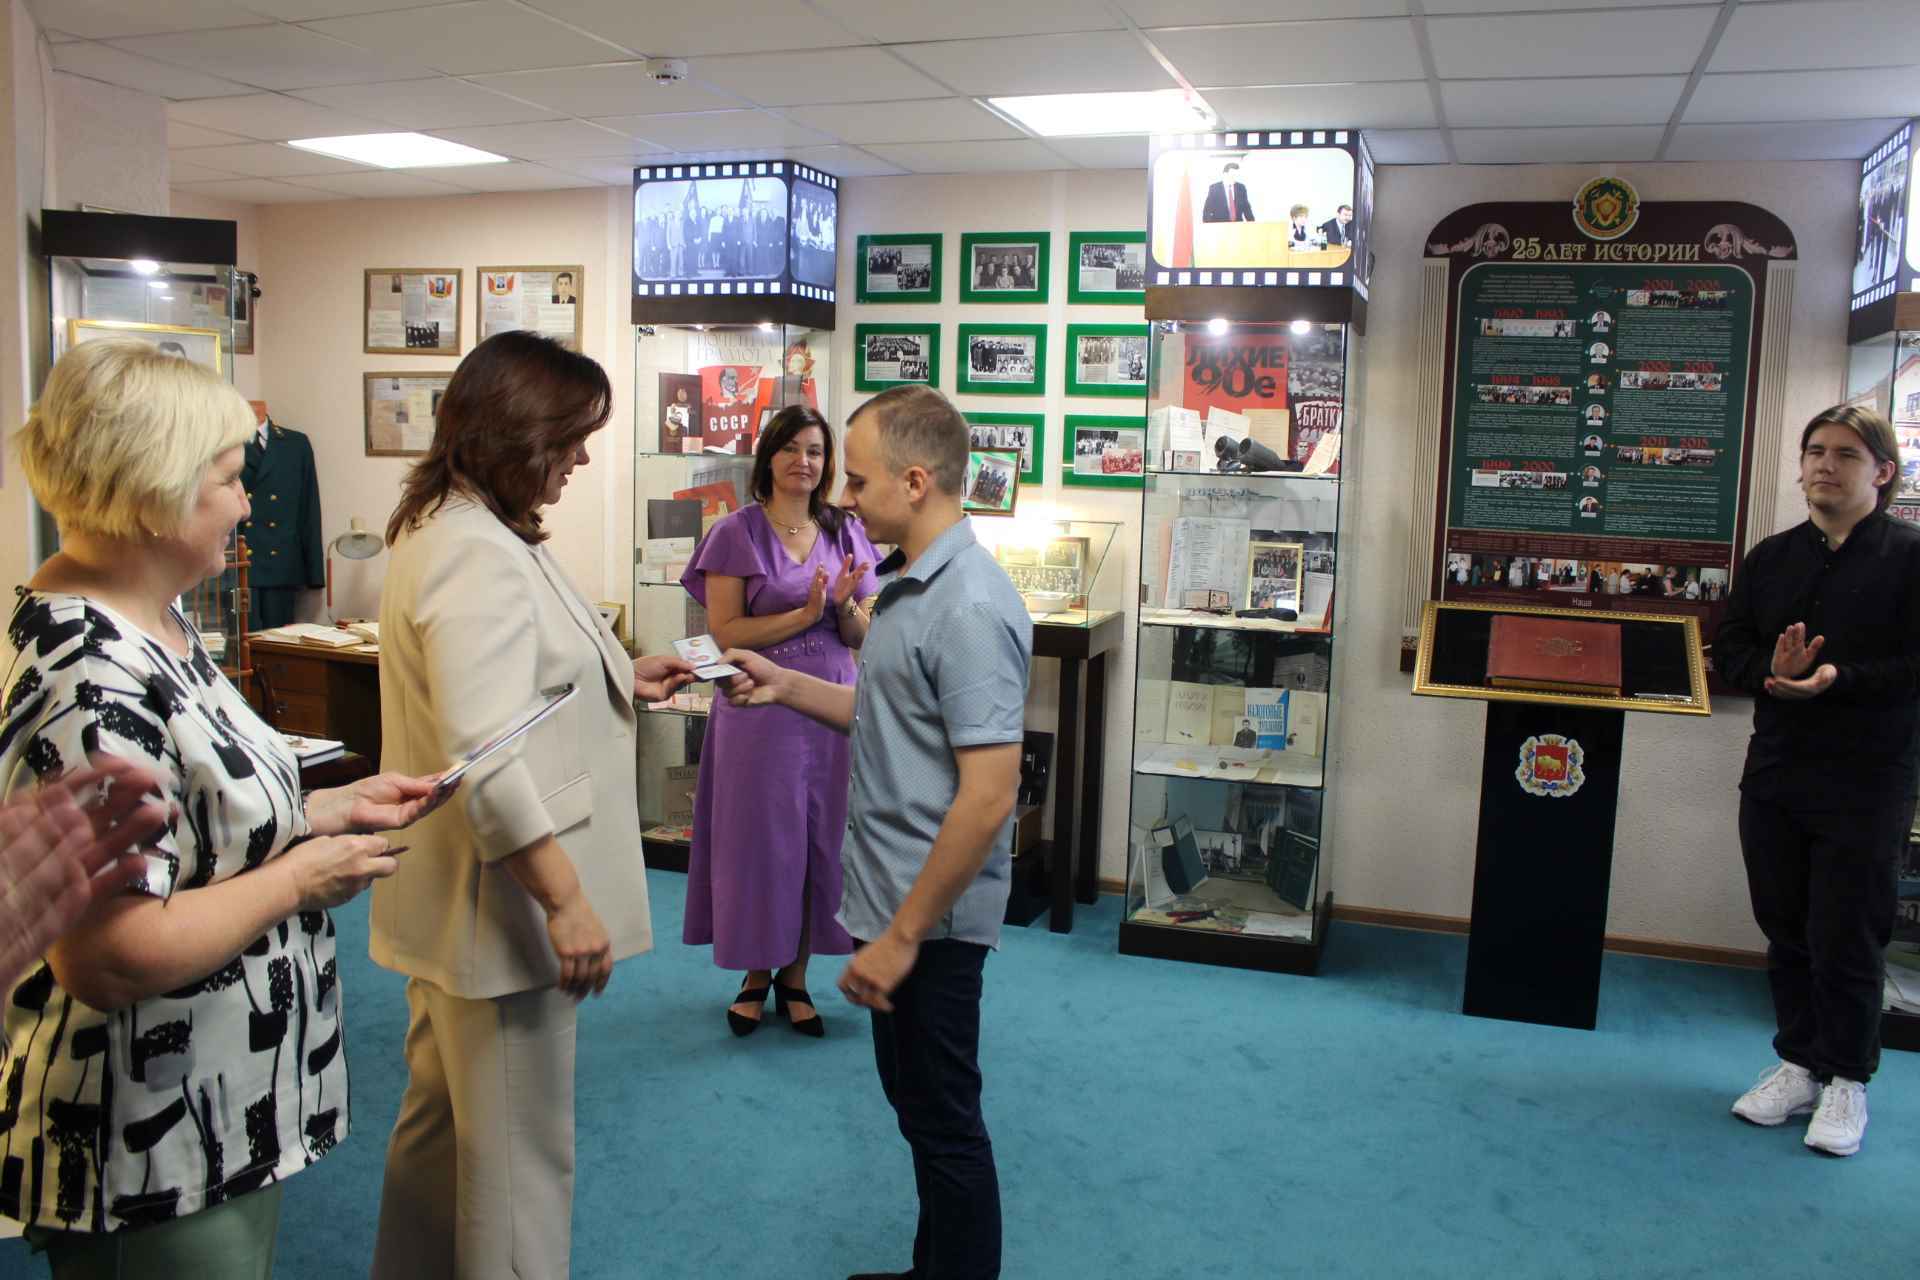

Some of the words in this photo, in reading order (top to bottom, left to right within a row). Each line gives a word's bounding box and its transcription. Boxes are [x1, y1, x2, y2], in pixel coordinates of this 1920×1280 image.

[1512, 238, 1541, 260] 25
[1544, 243, 1586, 261] ЛЕТ
[1595, 242, 1700, 262] ИСТОРИИ
[1187, 346, 1287, 369] ЛИХИЕ
[709, 415, 748, 432] СССР
